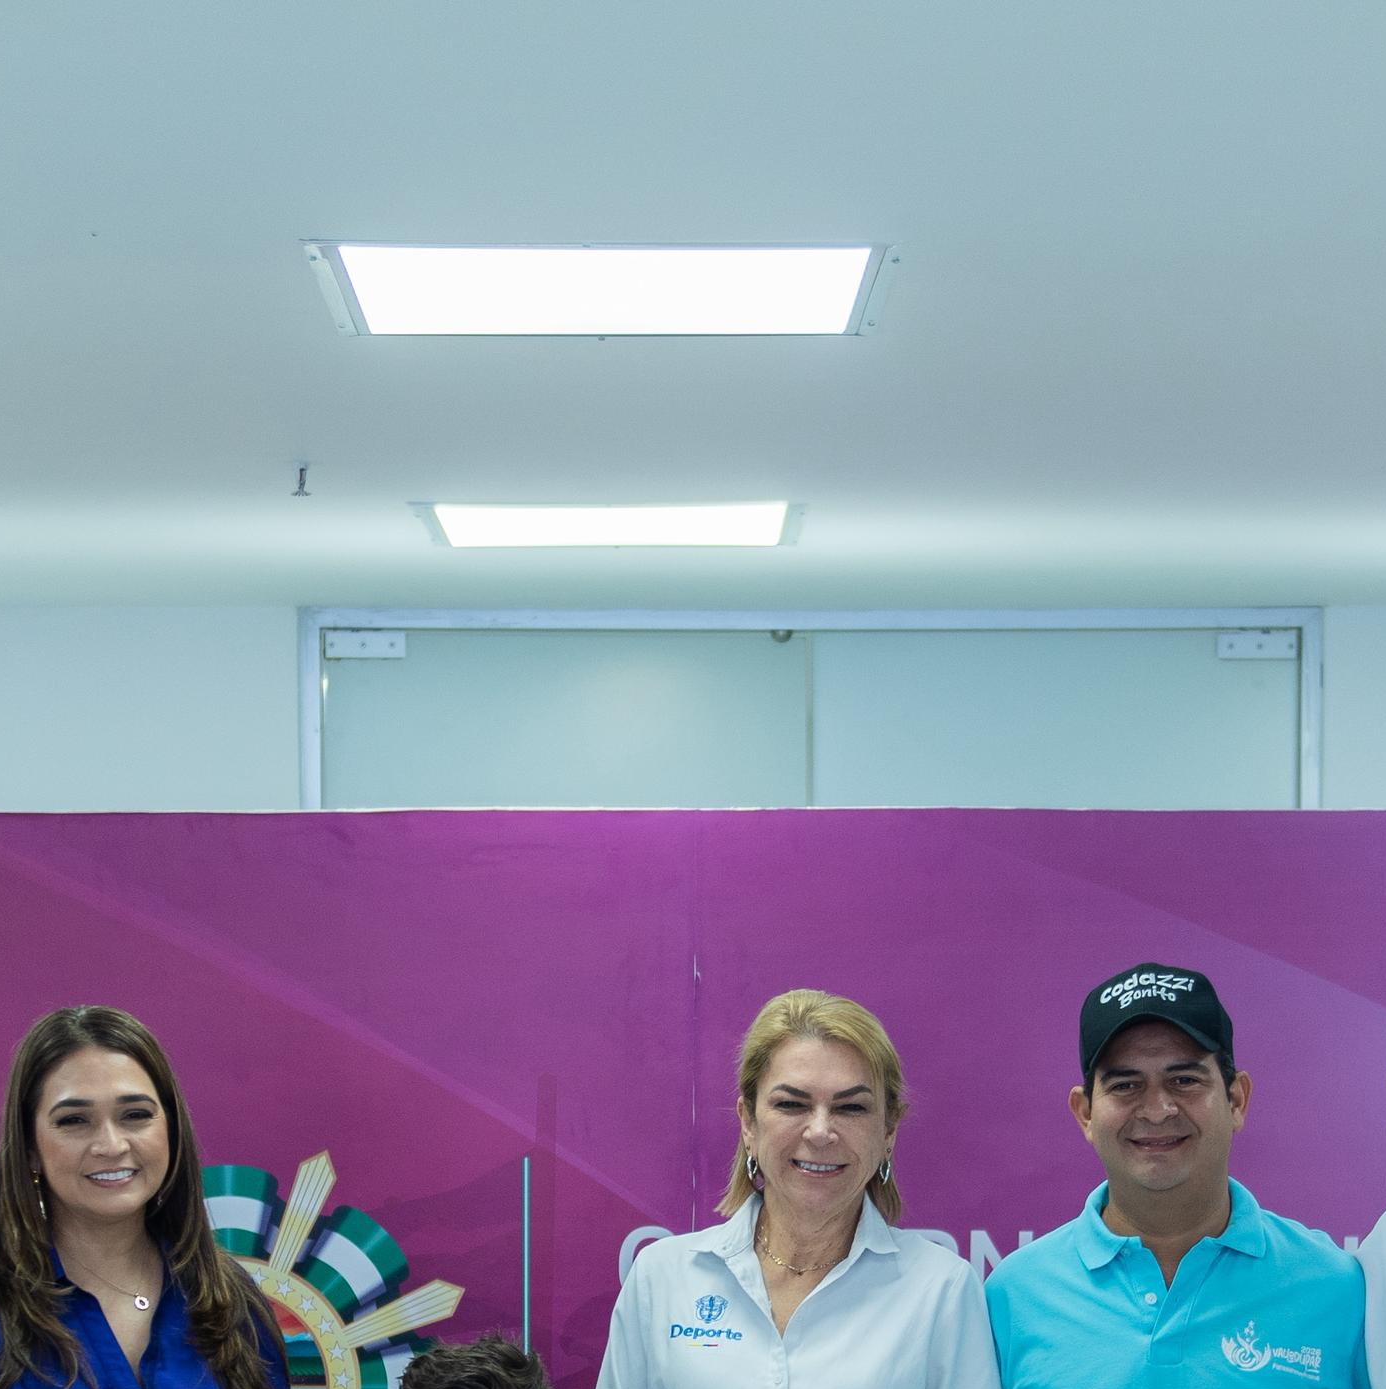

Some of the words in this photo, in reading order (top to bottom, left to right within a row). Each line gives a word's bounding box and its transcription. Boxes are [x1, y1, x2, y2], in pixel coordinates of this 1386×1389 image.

[1100, 973, 1194, 1004] Codazzi
[1118, 985, 1176, 1009] Bonito
[670, 1324, 742, 1340] Deporte
